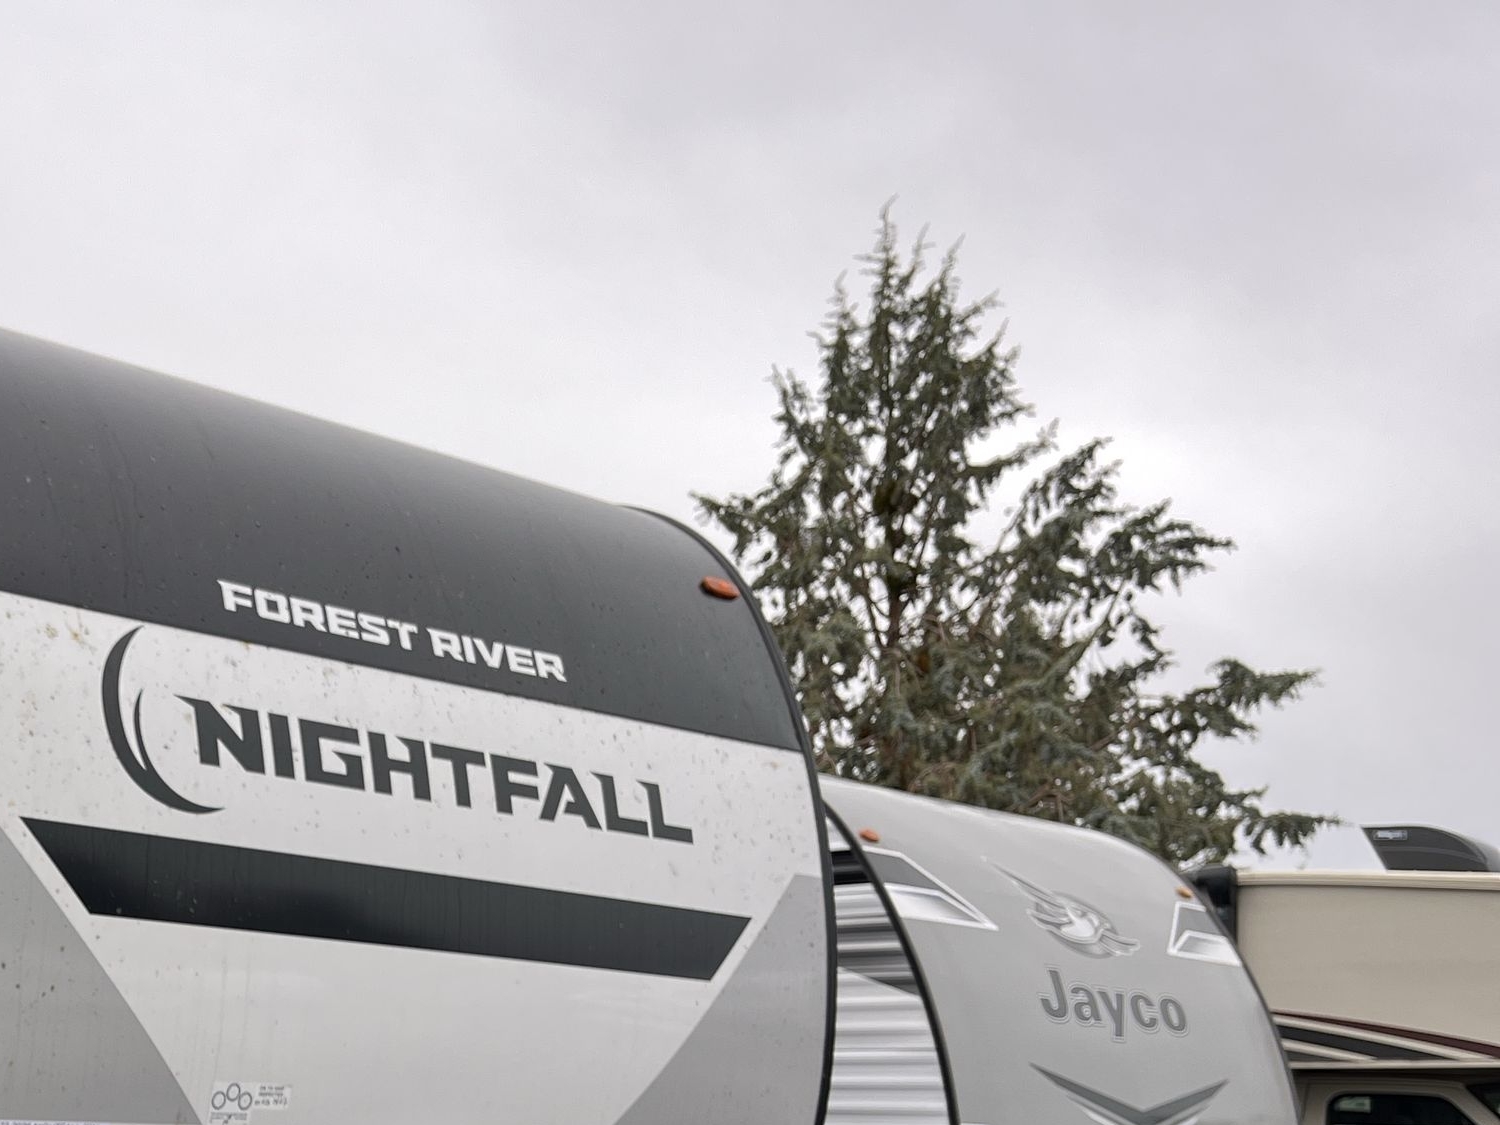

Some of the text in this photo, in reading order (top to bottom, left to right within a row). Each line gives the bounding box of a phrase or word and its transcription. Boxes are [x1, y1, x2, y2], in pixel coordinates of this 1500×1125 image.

[216, 578, 568, 683] FOREST RIVER
[174, 693, 695, 844] NIGHTFALL
[1038, 966, 1189, 1041] Jayco
